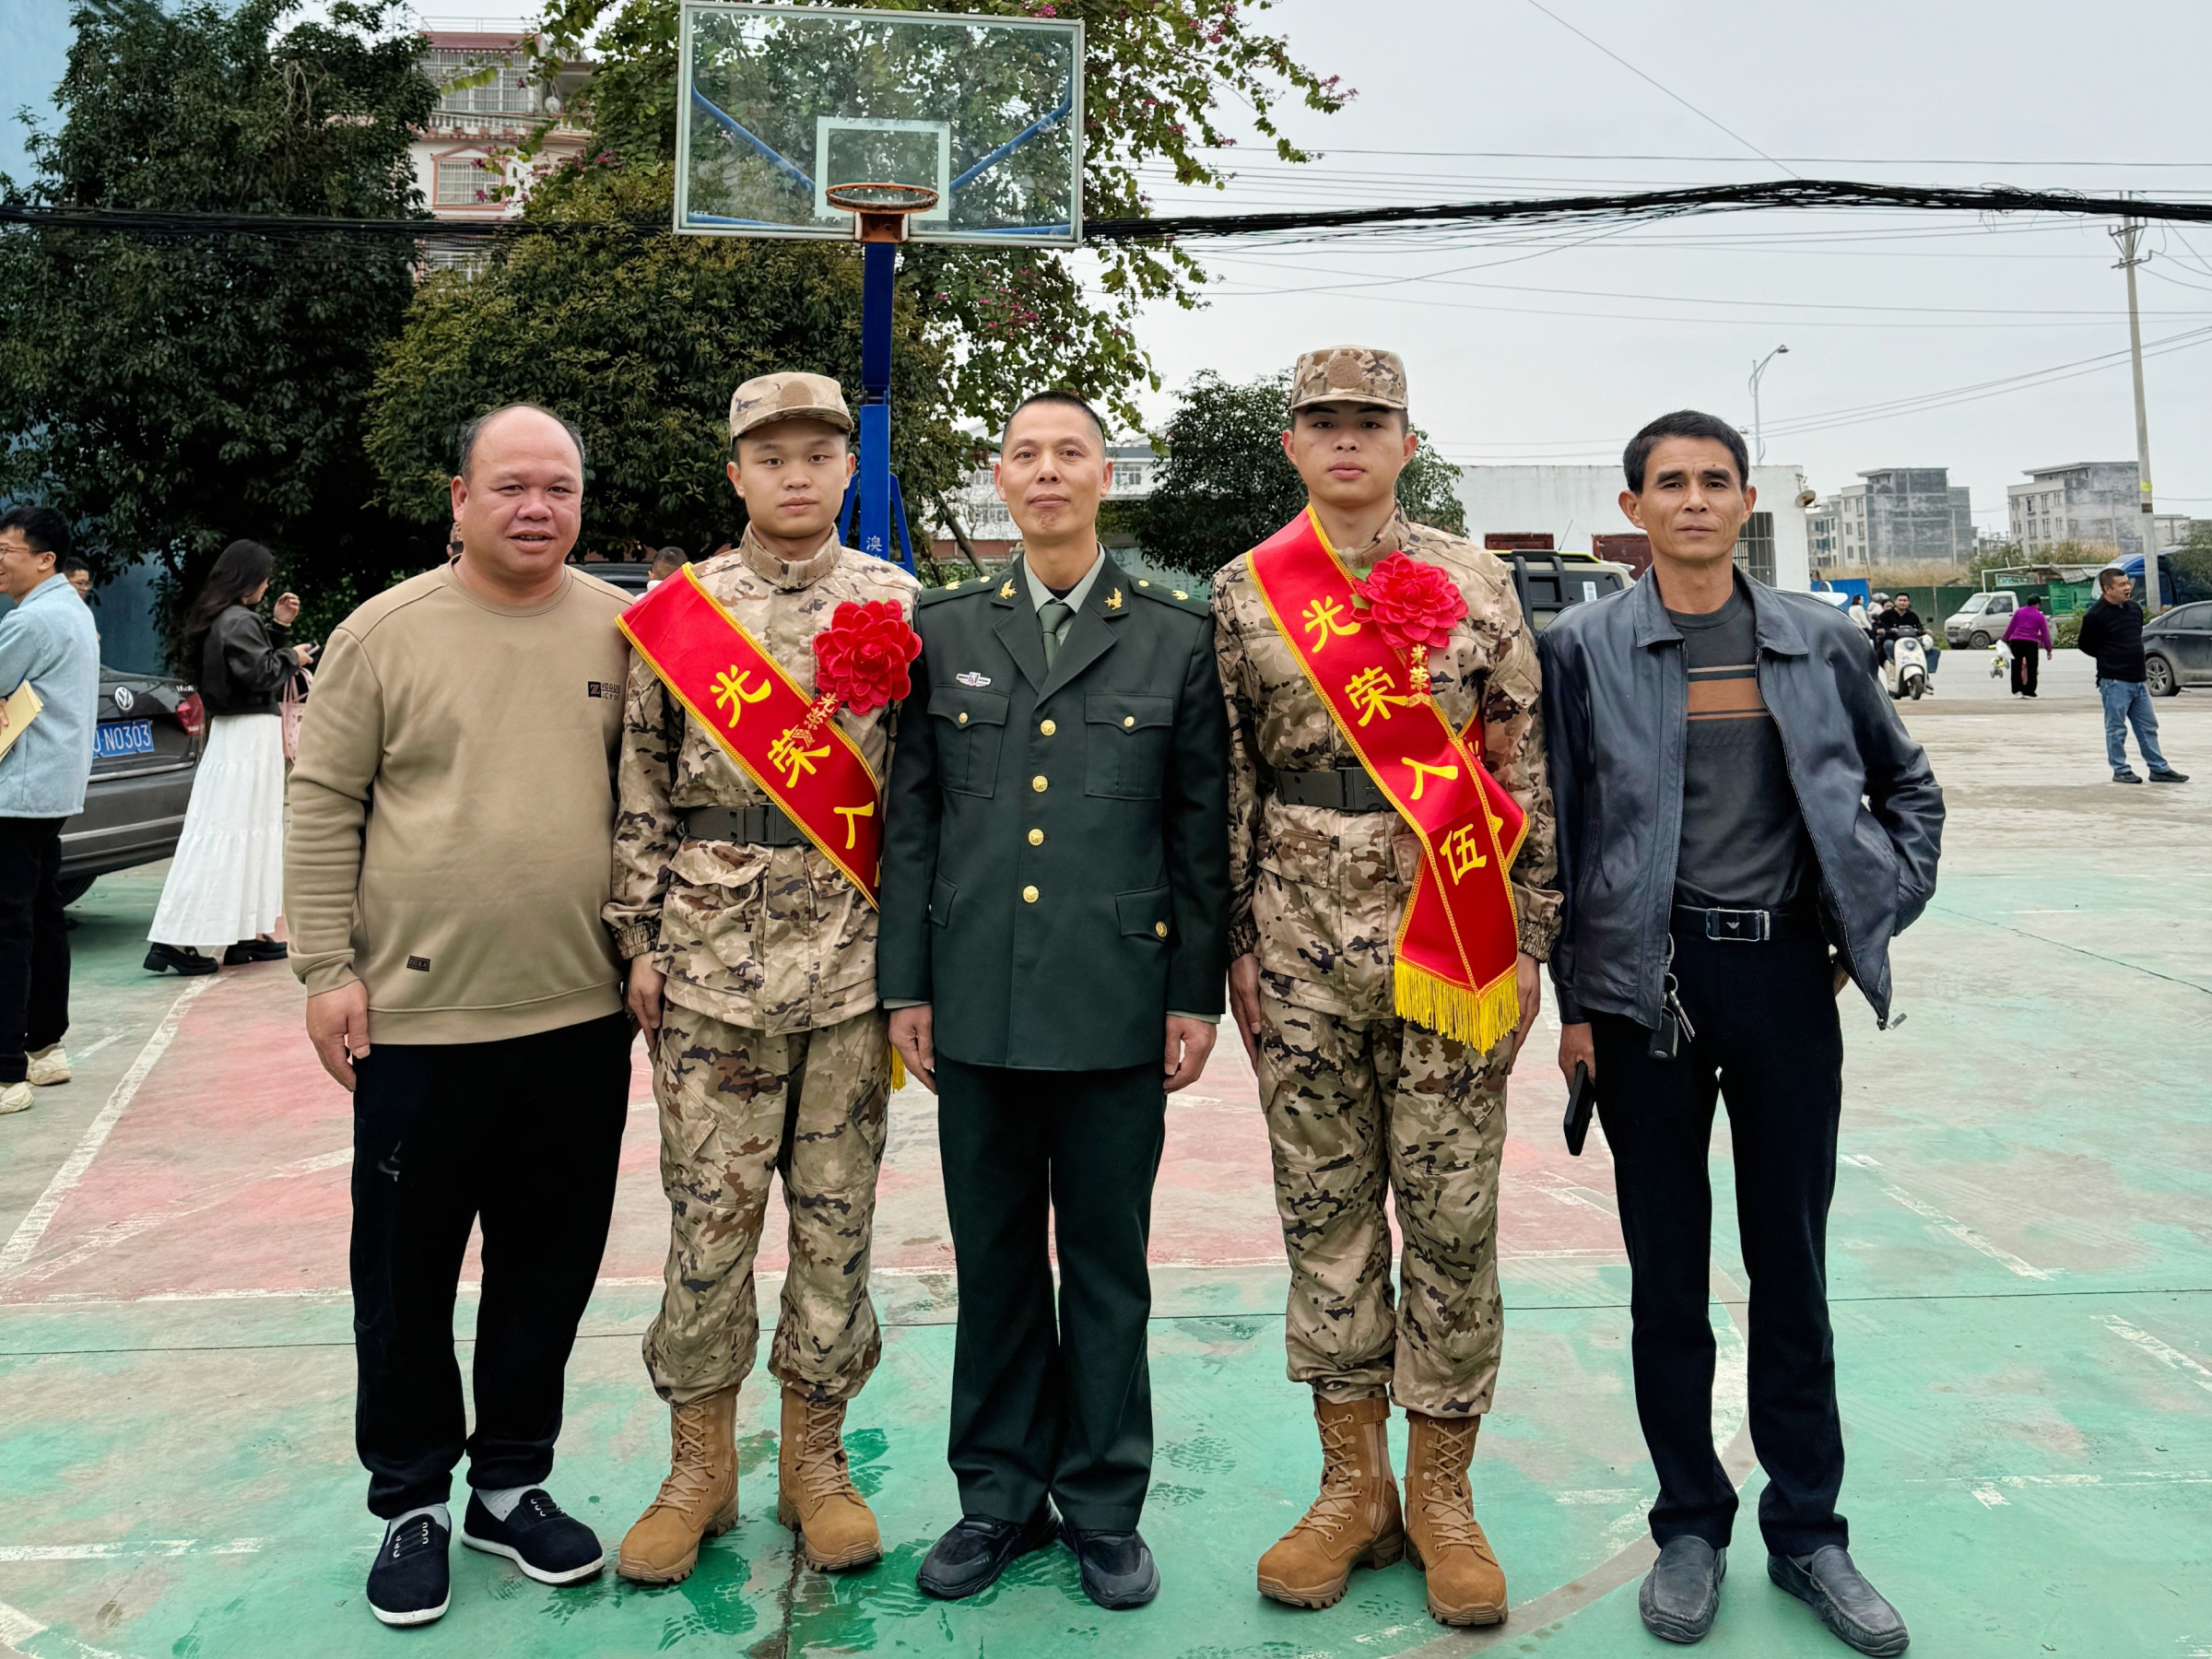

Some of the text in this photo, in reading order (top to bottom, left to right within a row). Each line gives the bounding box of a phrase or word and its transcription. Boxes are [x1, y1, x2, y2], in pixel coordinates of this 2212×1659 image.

[1409, 643, 1430, 691] 光荣
[804, 691, 840, 731] 光荣
[710, 664, 881, 888] 光荣入
